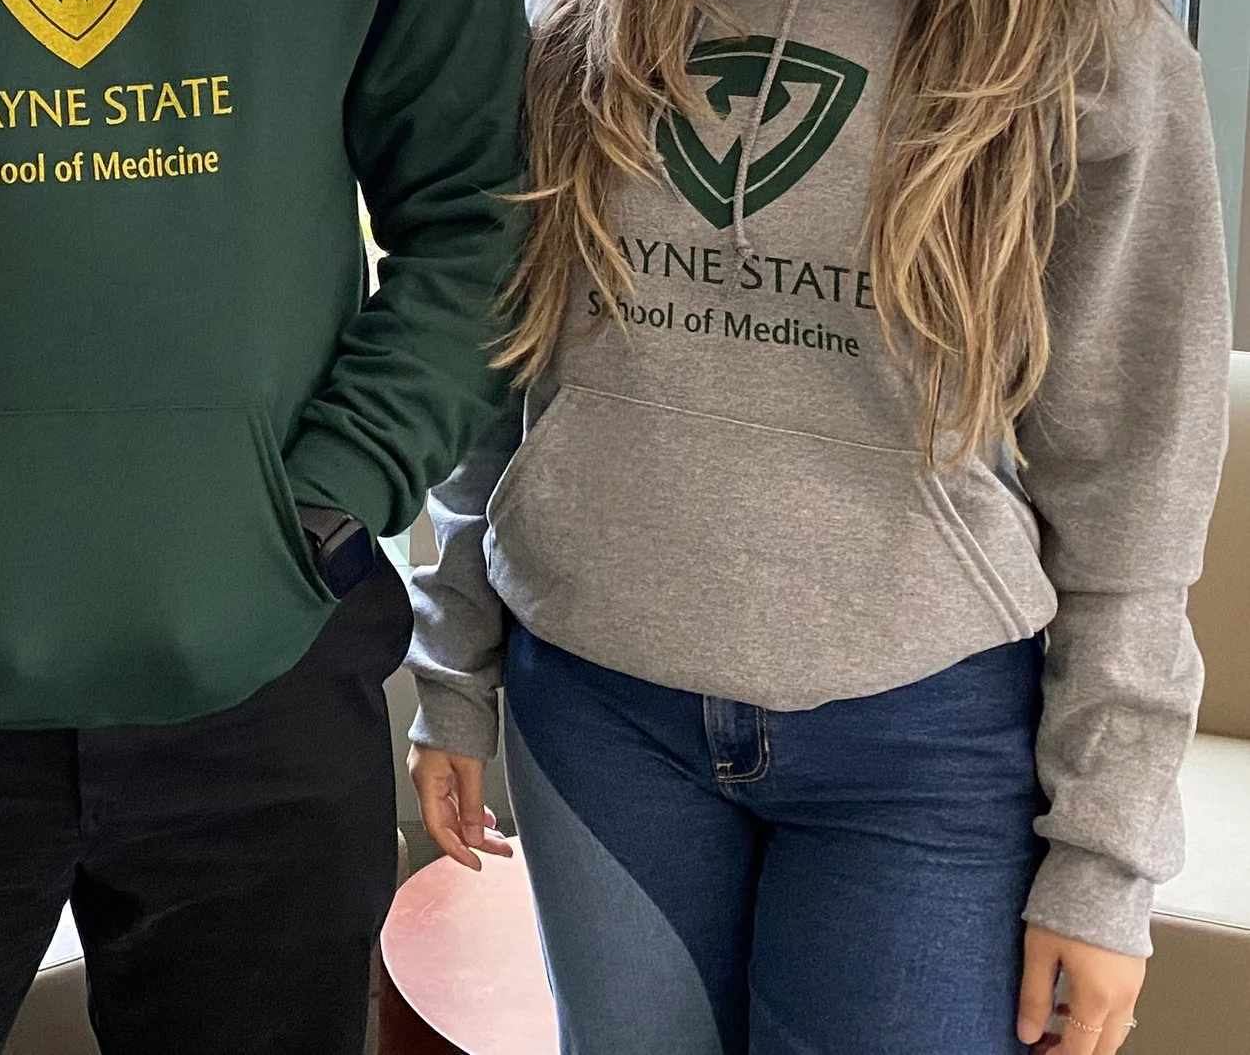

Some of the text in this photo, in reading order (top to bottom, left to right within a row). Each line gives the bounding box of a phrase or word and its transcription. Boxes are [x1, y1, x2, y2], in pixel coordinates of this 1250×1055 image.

[104, 75, 233, 126] STATE
[54, 151, 85, 183] of
[92, 146, 220, 181] Medicine
[587, 231, 877, 311] YNE STATE
[588, 290, 861, 358] Shool of Medicine
